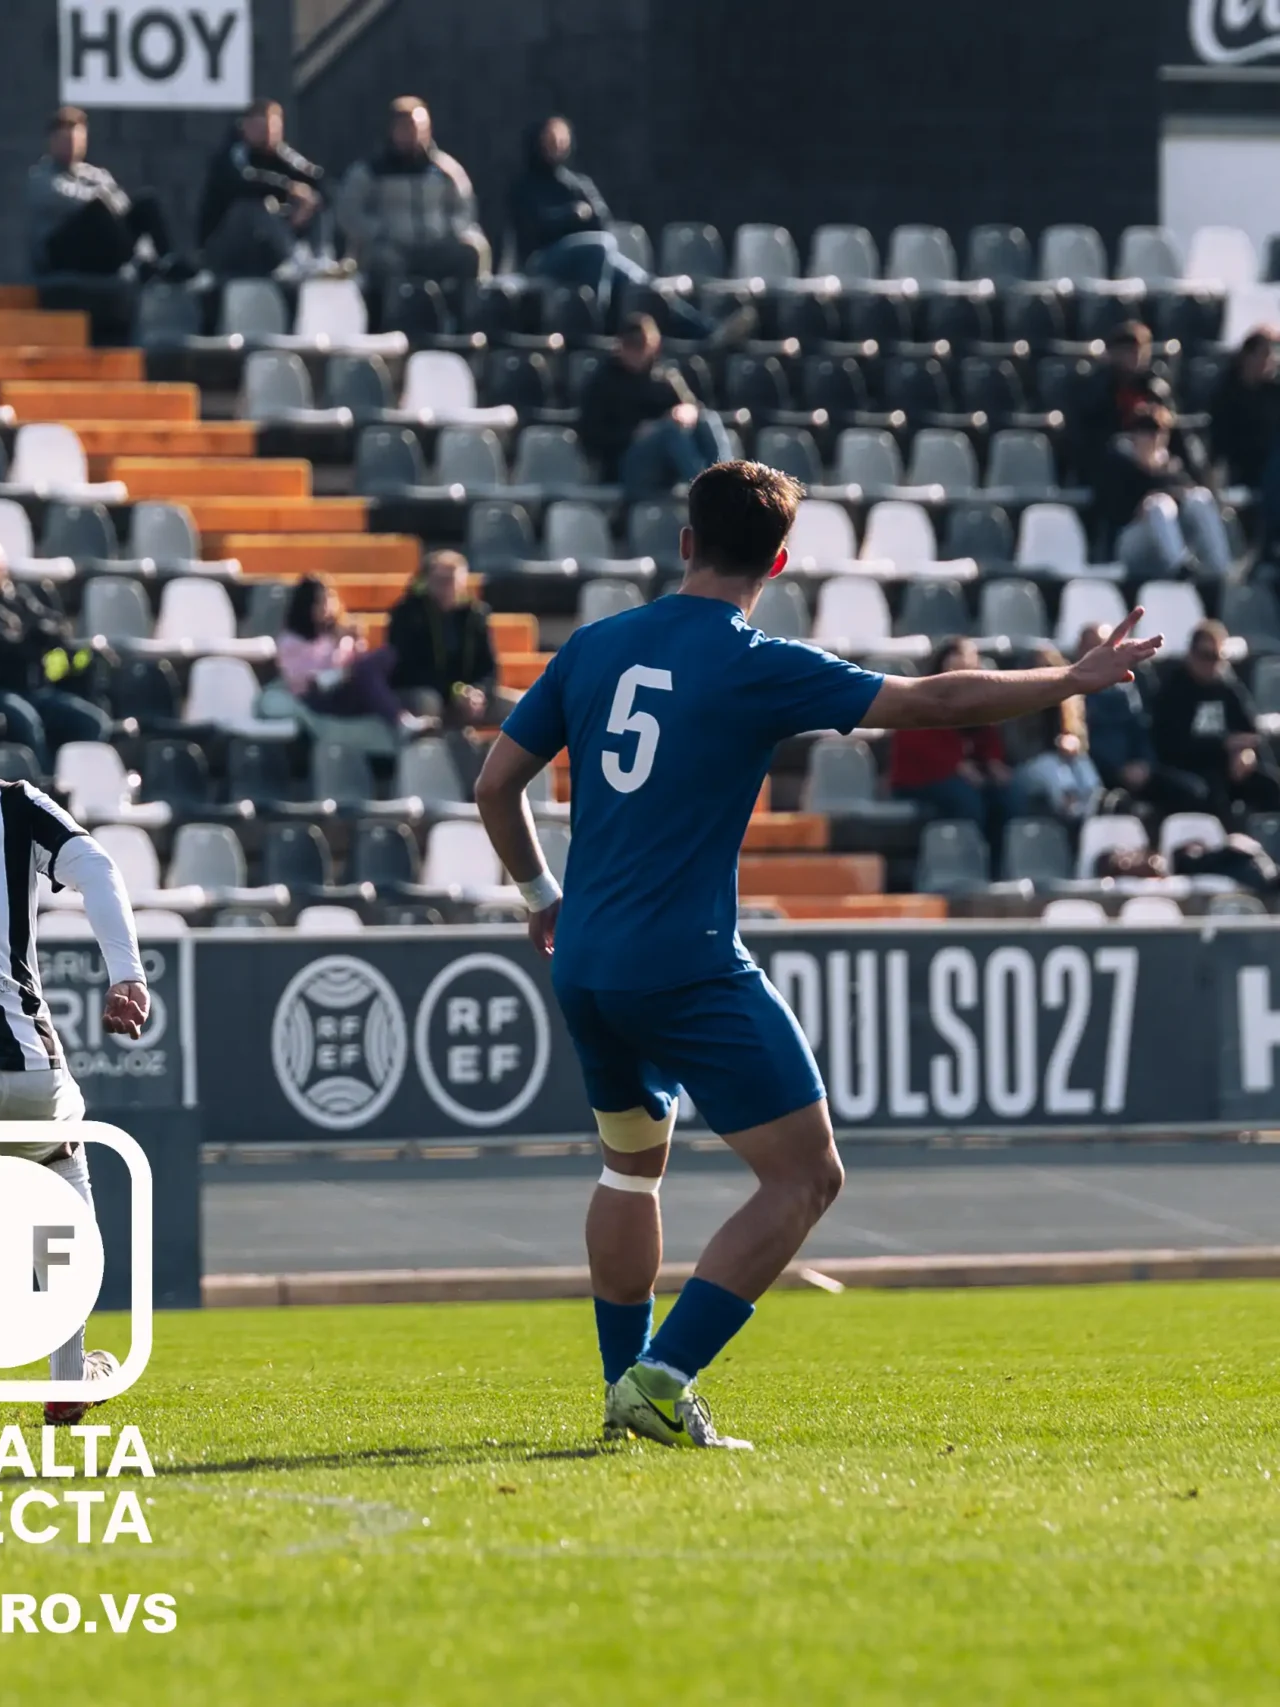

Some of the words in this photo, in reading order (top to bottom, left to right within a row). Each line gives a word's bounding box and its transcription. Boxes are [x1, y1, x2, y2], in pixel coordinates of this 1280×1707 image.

[68, 8, 238, 82] HOY
[601, 664, 673, 794] 5
[447, 996, 521, 1035] RF
[447, 1044, 521, 1084] EF
